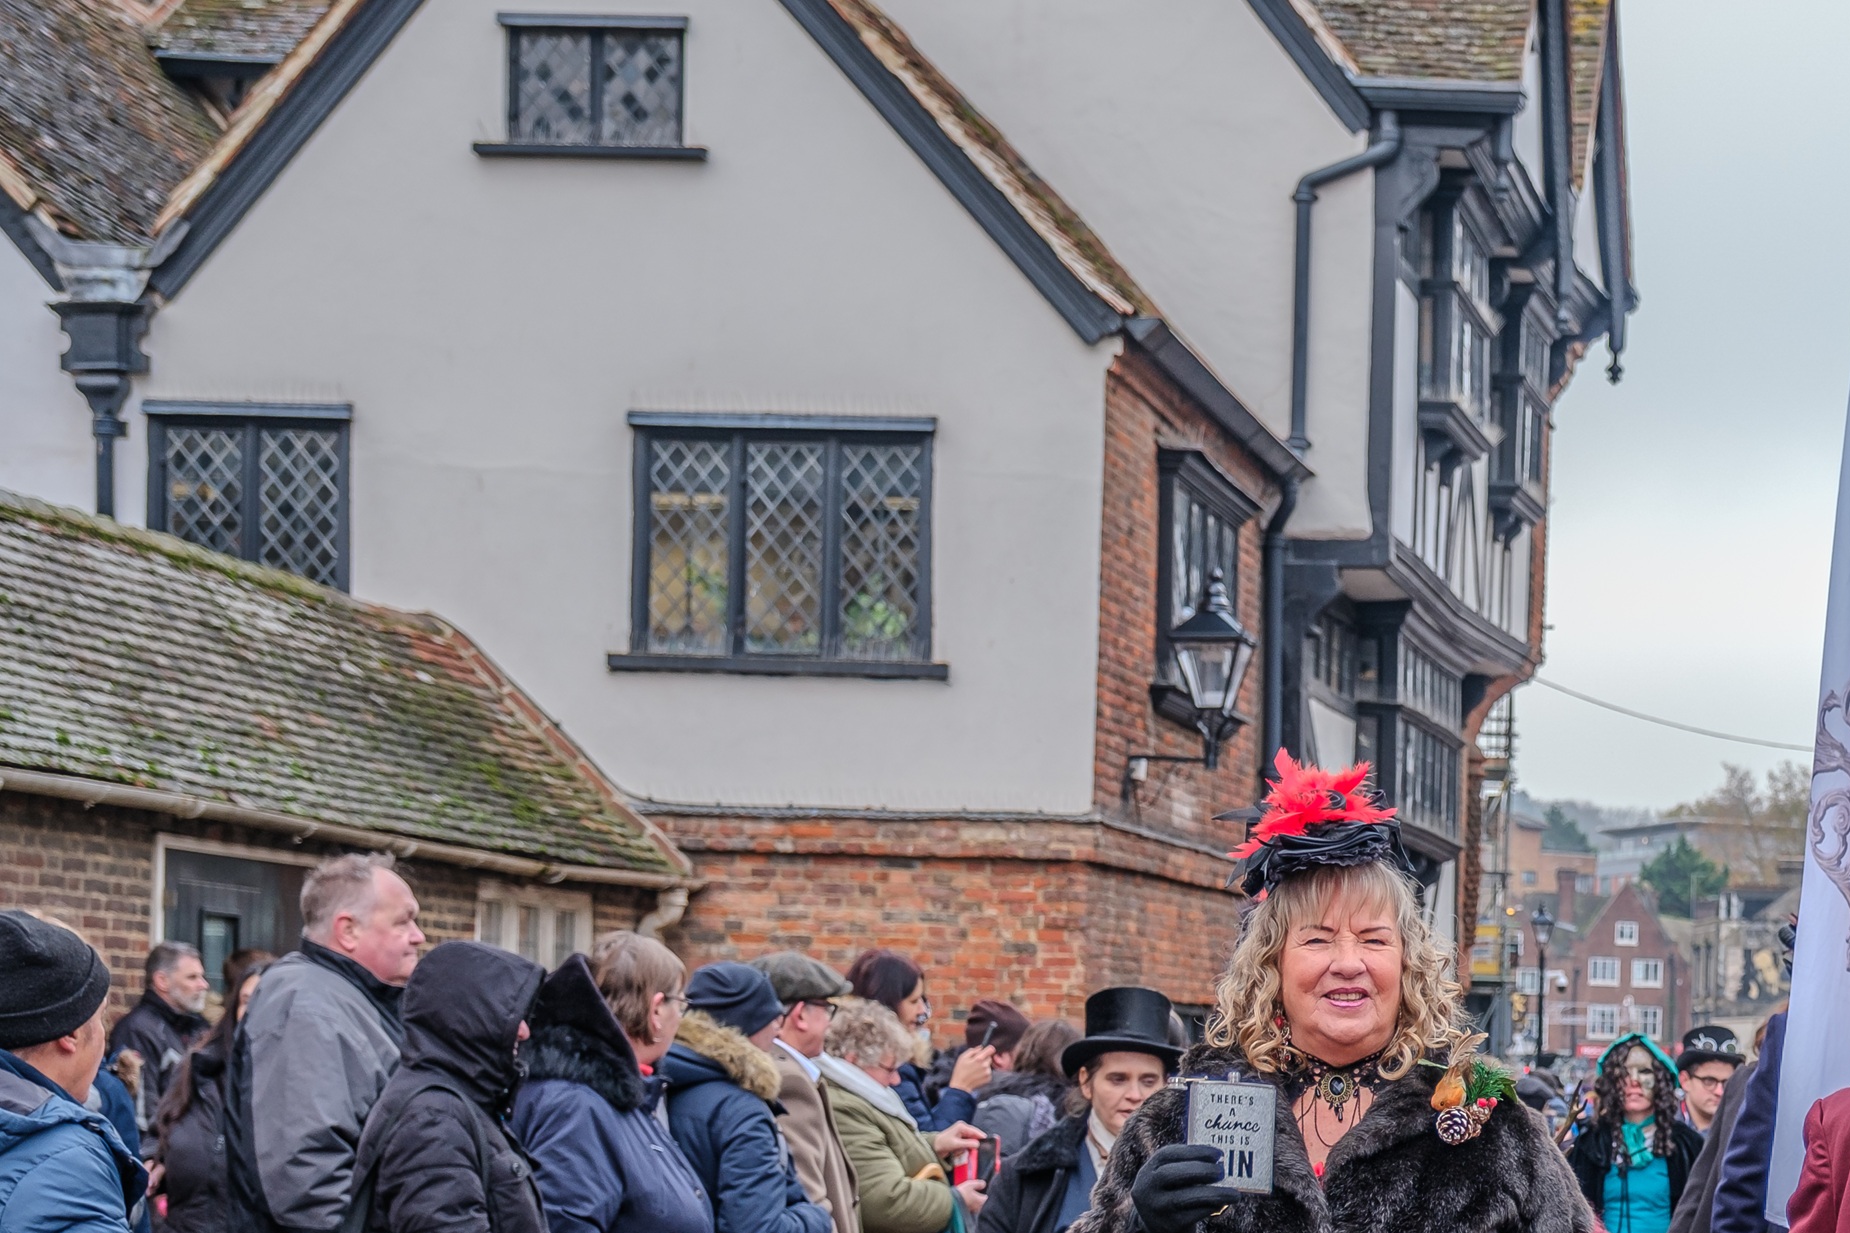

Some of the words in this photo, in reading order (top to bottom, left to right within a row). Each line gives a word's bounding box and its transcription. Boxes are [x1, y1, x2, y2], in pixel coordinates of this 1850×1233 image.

[1211, 1094, 1254, 1105] THERE'S
[1229, 1107, 1236, 1117] A
[1205, 1113, 1260, 1133] chance
[1211, 1134, 1235, 1145] THIS
[1240, 1136, 1250, 1146] IS
[1228, 1150, 1253, 1178] IN
